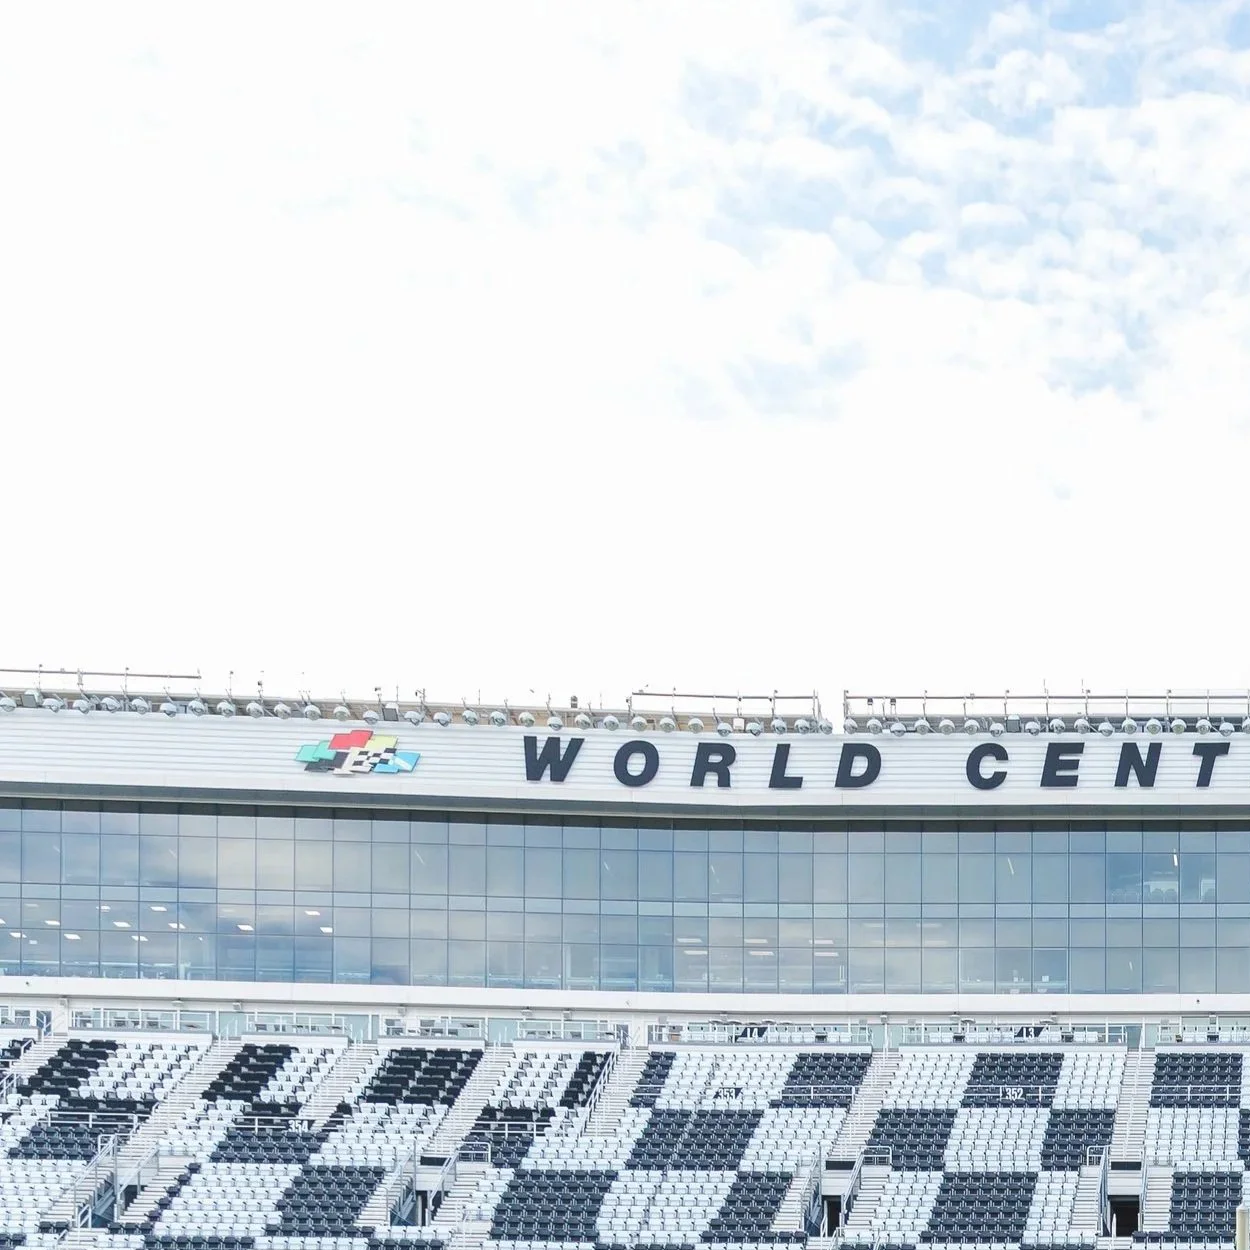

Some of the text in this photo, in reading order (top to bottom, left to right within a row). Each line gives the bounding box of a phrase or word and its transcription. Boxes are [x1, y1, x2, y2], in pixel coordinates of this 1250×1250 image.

[523, 735, 882, 788] WORLD
[718, 1088, 736, 1099] 353
[1005, 1087, 1024, 1100] 352
[288, 1120, 308, 1132] 354
